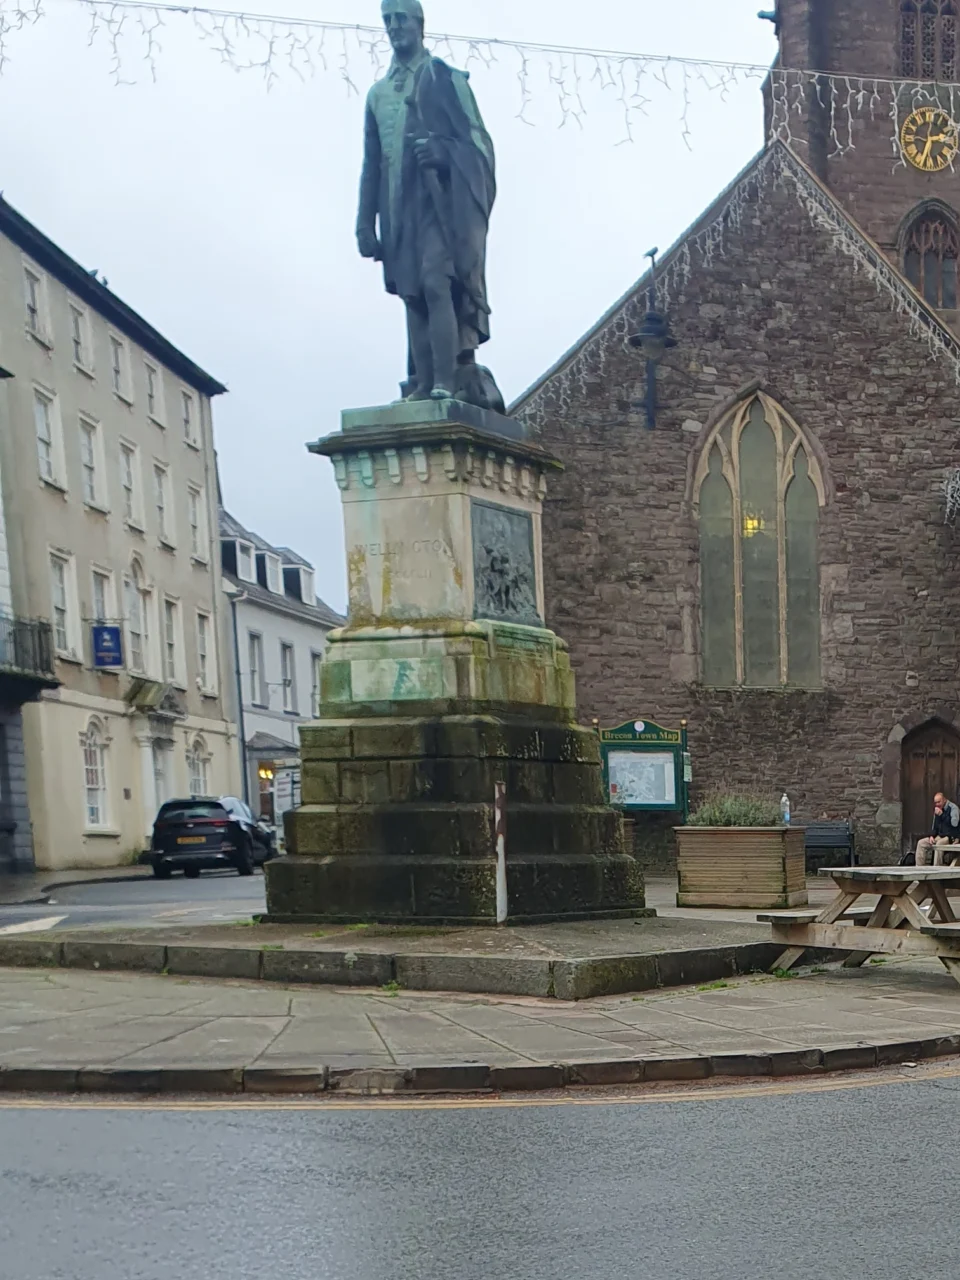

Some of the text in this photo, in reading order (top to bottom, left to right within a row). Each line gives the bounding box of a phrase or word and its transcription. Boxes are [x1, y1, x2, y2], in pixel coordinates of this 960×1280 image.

[604, 731, 678, 741] Brecon Town Map
